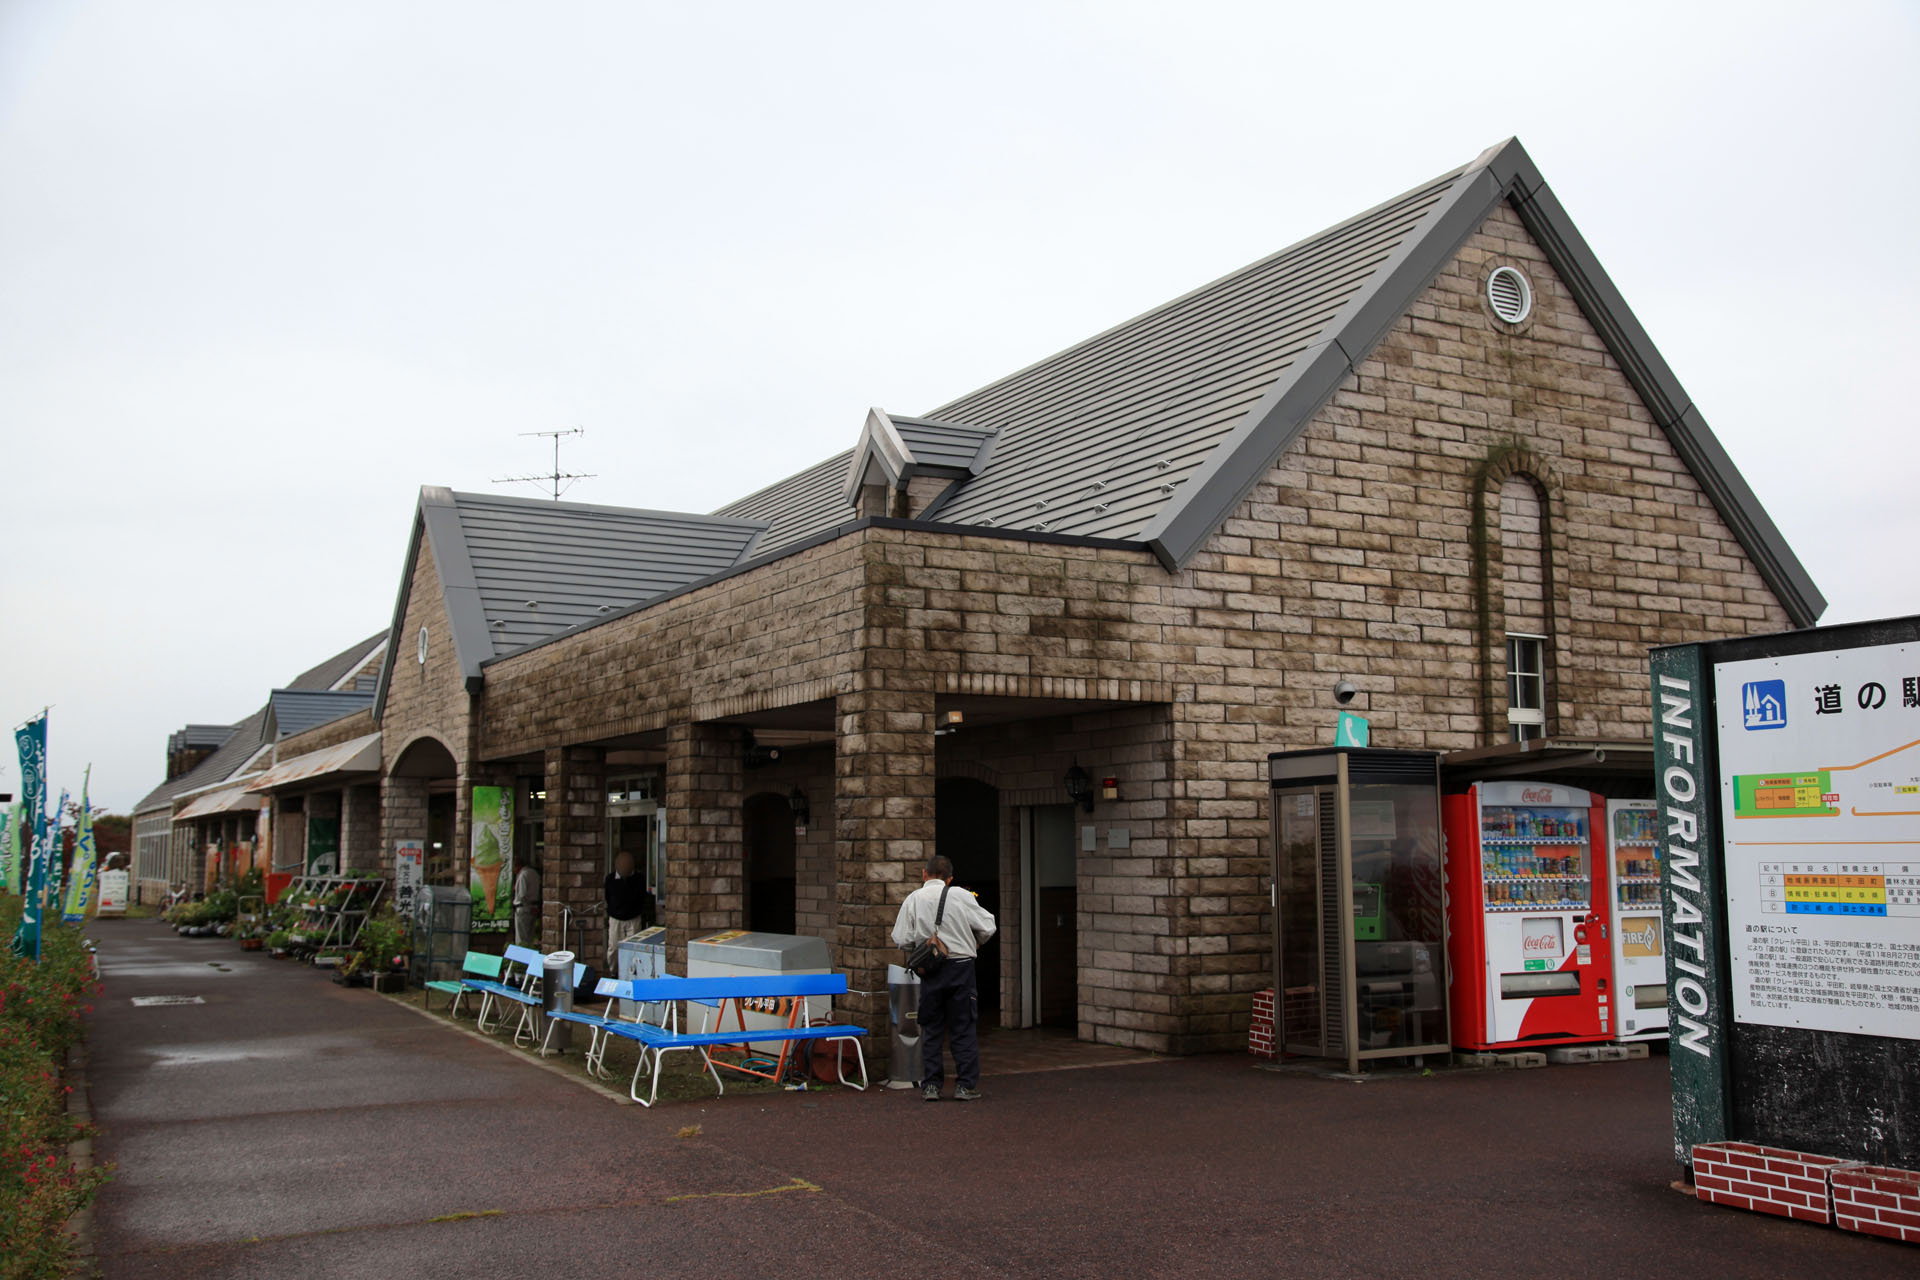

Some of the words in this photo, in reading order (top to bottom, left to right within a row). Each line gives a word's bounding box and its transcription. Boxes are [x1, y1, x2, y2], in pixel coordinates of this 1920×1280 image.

[1814, 677, 1920, 715] 道の駅
[1659, 674, 1710, 1058] INFORMATION
[1745, 925, 1798, 934] 道の駅について
[1523, 934, 1555, 950] Coca-Cola
[1622, 931, 1644, 944] FIRE
[744, 997, 775, 1010] クレール平田
